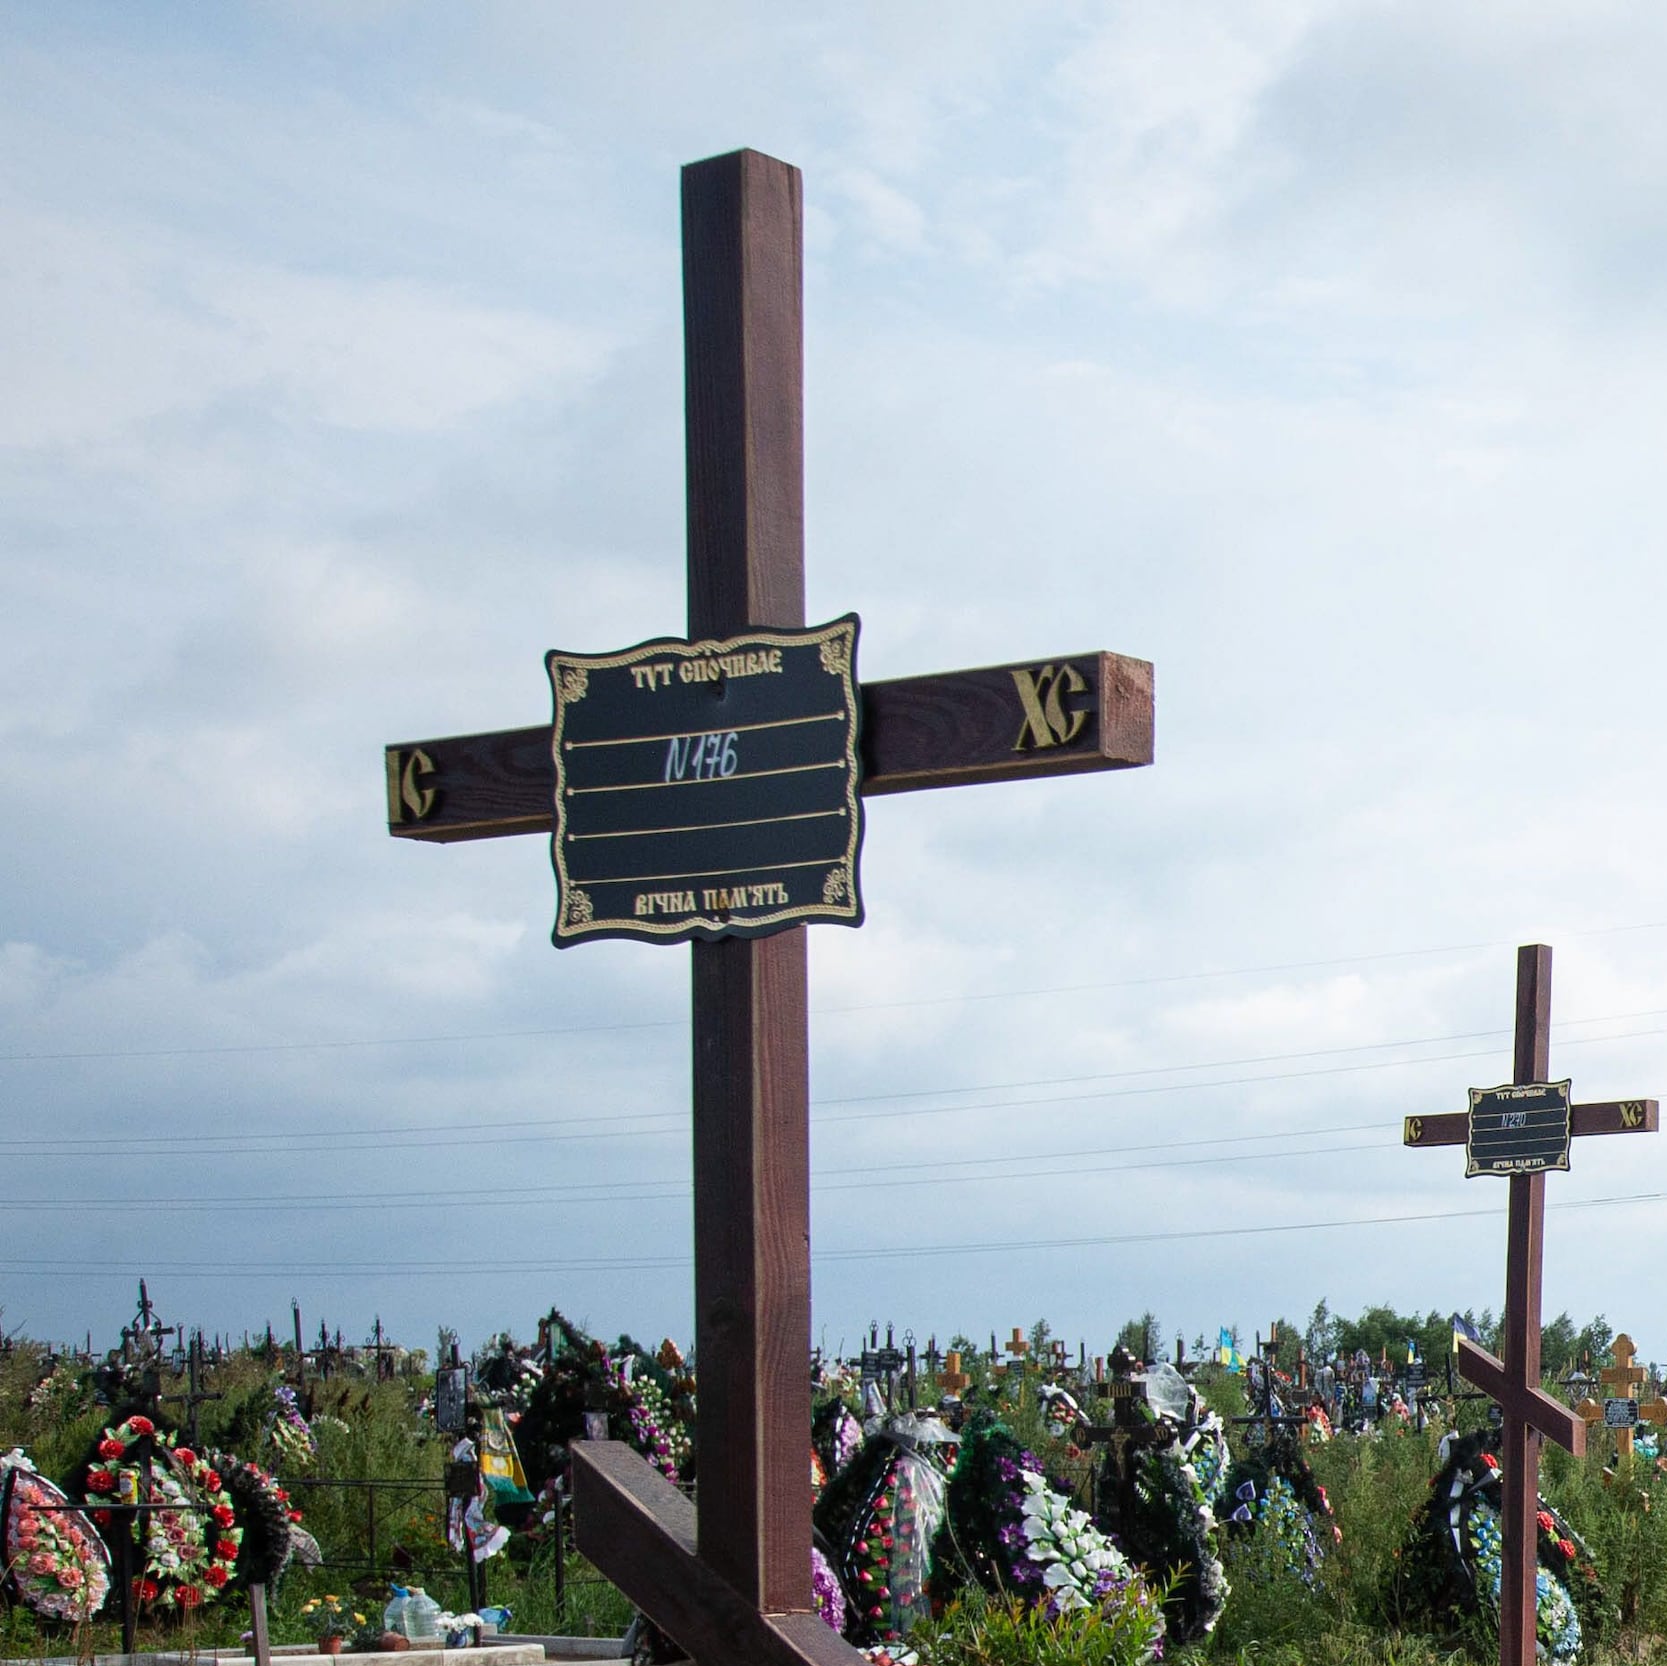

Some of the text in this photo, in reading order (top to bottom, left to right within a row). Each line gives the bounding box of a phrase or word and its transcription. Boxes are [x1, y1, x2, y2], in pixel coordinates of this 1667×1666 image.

[630, 649, 784, 692] ТУТ СПОЧИВАЄ
[634, 890, 697, 916] ВІЧНА
